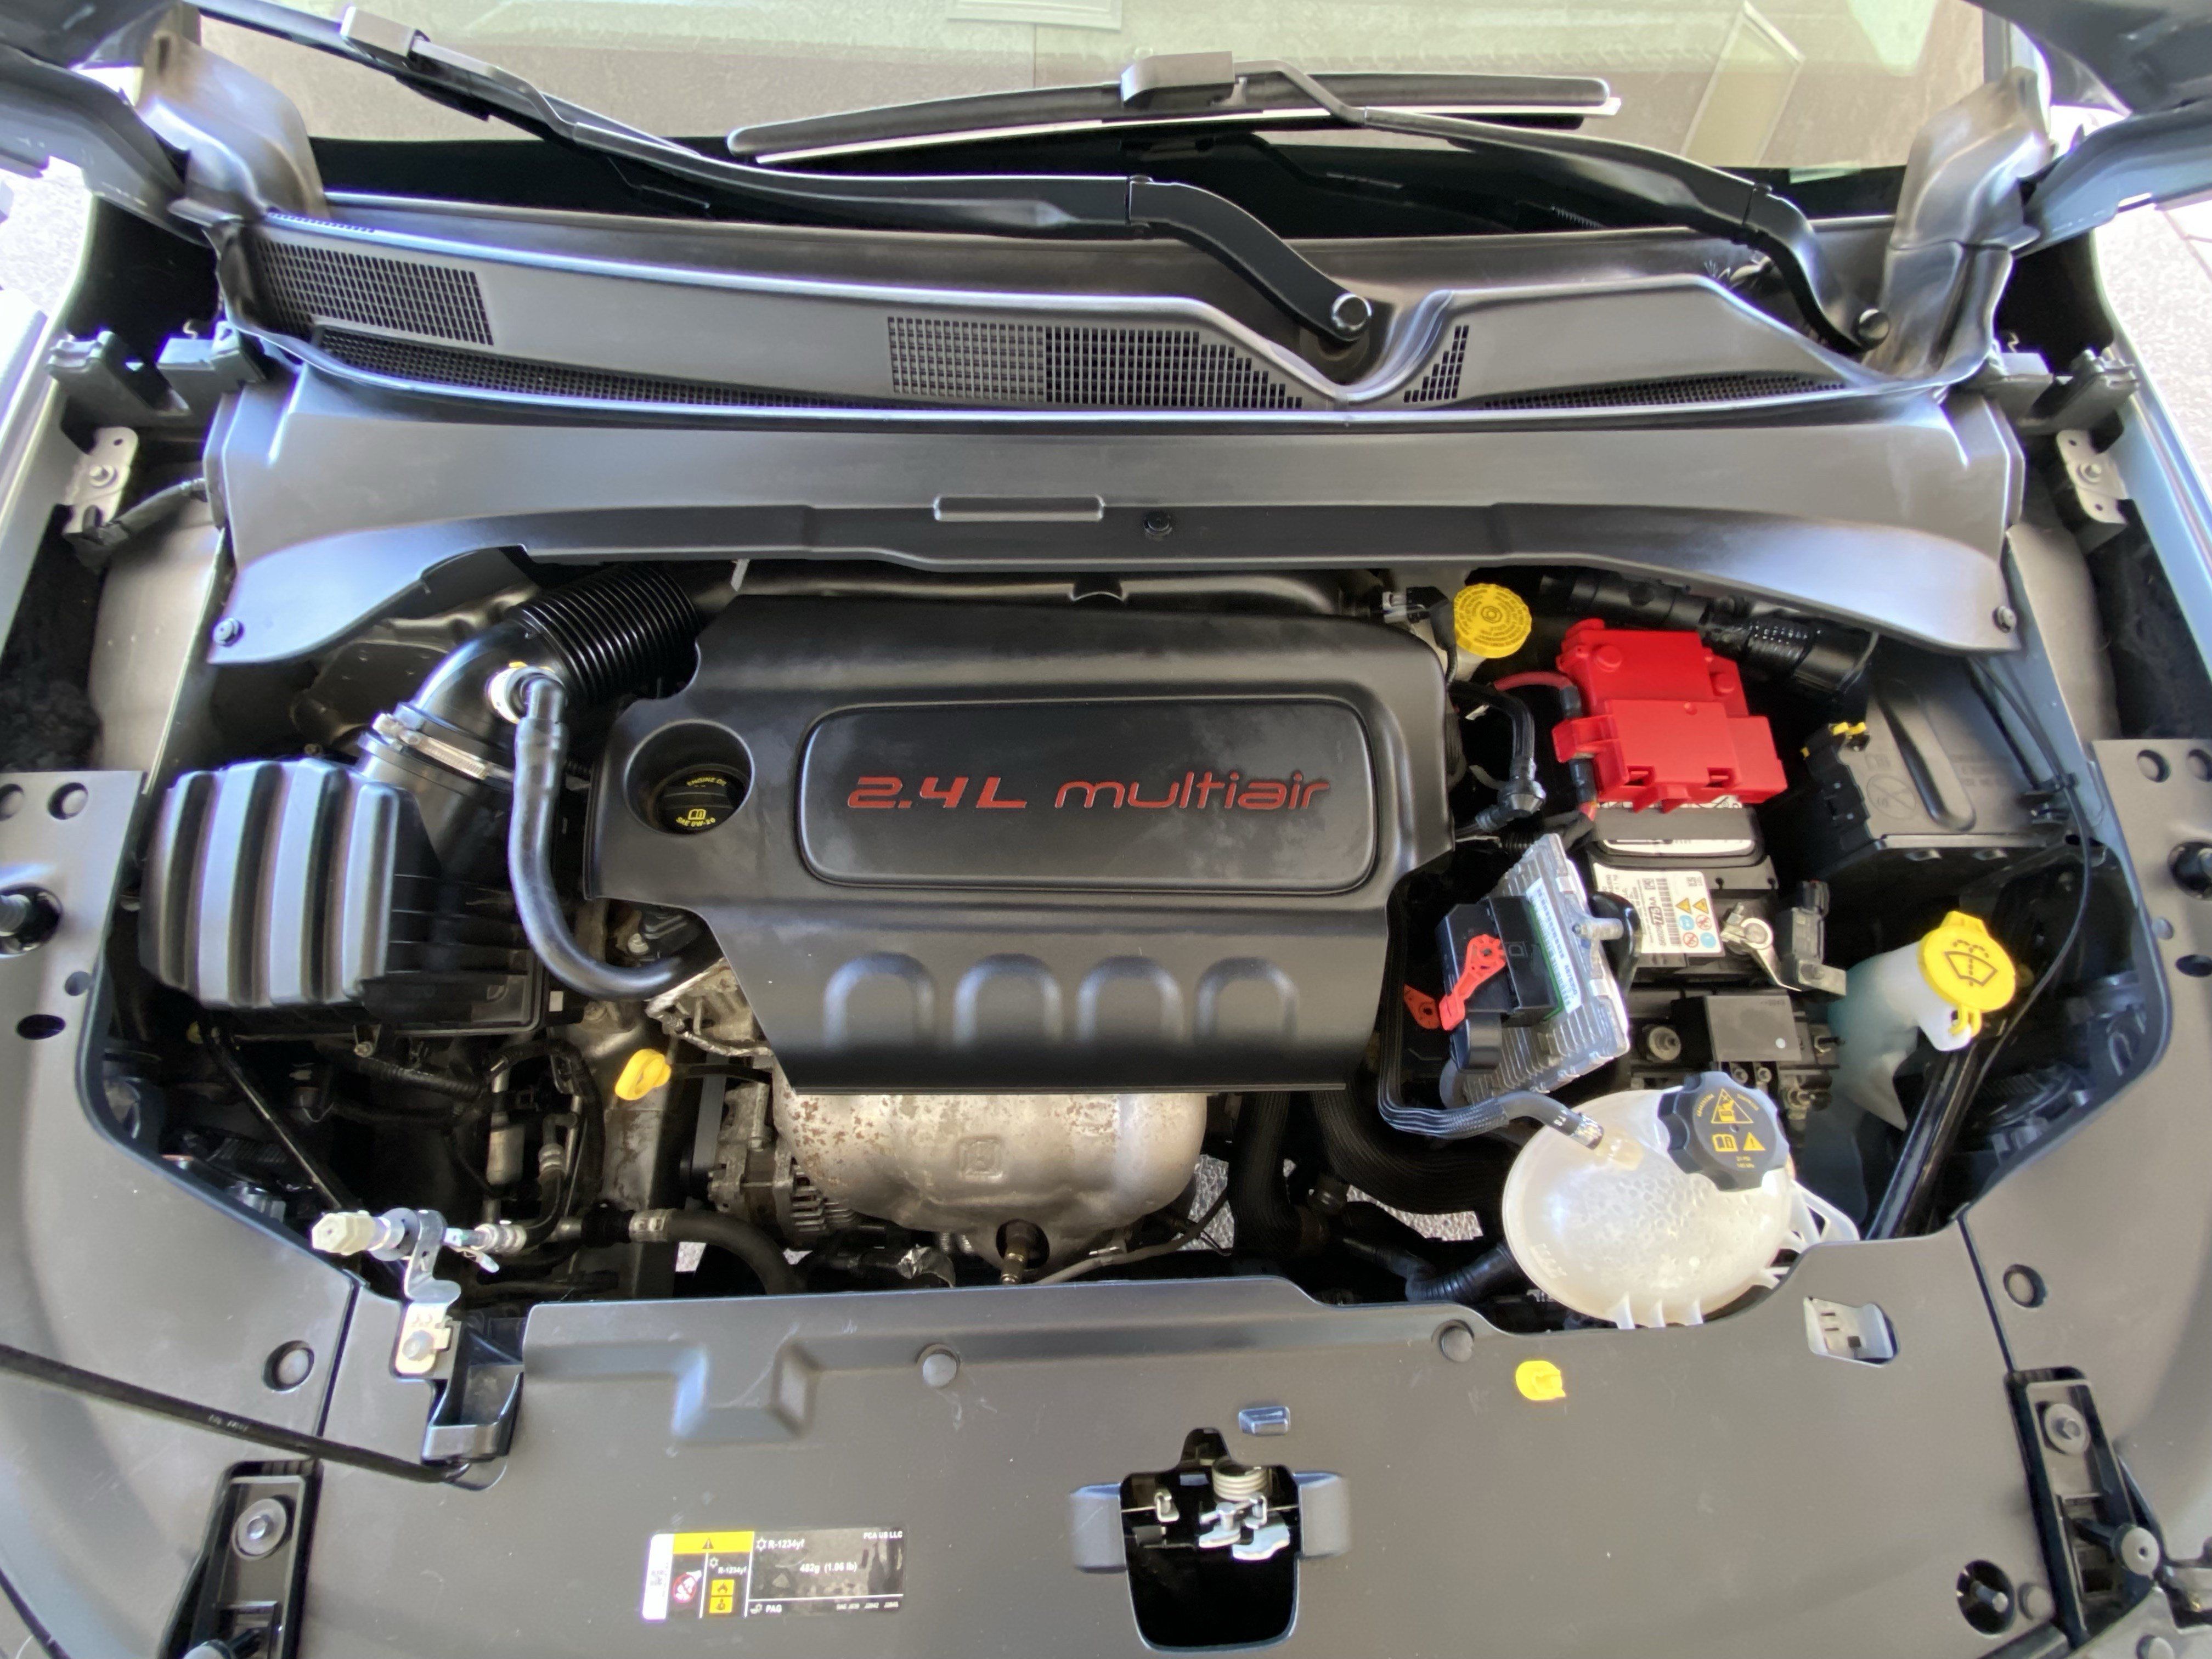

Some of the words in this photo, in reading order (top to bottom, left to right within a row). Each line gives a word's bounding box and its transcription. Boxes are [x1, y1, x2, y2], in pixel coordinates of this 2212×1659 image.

[686, 777, 715, 786] ENGINE
[848, 776, 1026, 809] 2.4L
[1054, 771, 1330, 810] multiair
[676, 816, 690, 826] SAE
[691, 817, 715, 827] 0W-20
[863, 1531, 877, 1539] FCA
[889, 1530, 903, 1538] LLC
[768, 1538, 805, 1550] R-1234yf
[718, 1565, 747, 1575] R-1234yf
[845, 1561, 857, 1572] lb)
[765, 1604, 782, 1613] PAG
